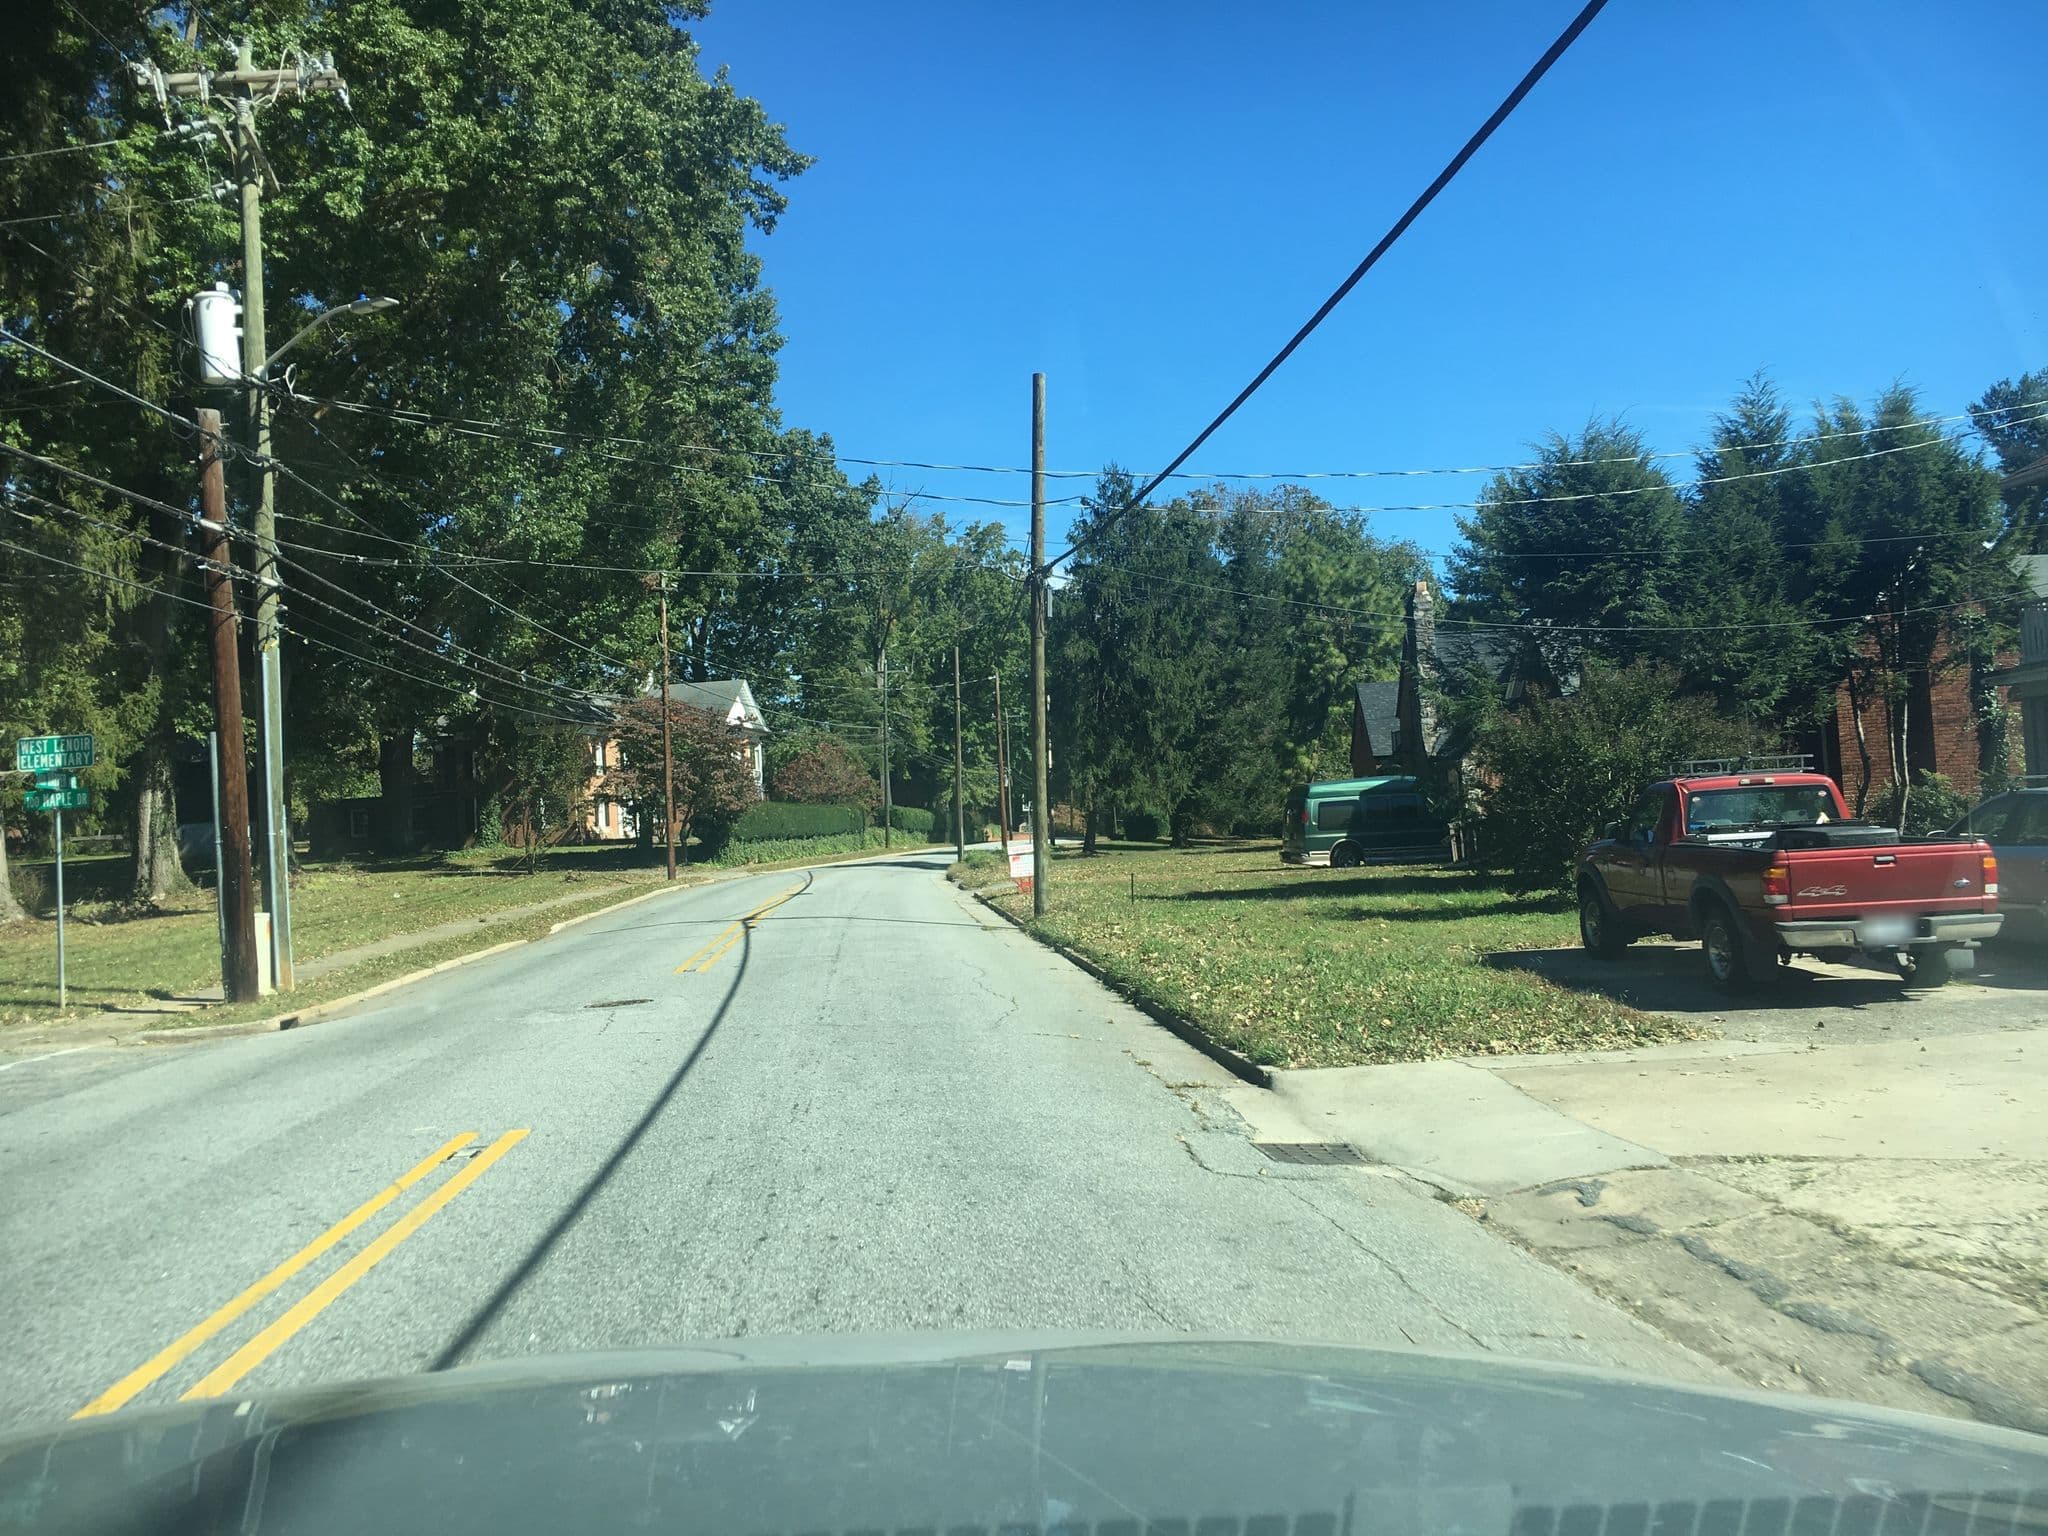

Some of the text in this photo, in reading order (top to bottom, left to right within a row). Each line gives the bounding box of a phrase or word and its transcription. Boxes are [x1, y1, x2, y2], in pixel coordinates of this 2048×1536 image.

[20, 737, 91, 754] WEST LENOIR
[21, 752, 90, 769] ELEMENTARY
[42, 792, 72, 807] MAPLE
[77, 793, 87, 805] DR
